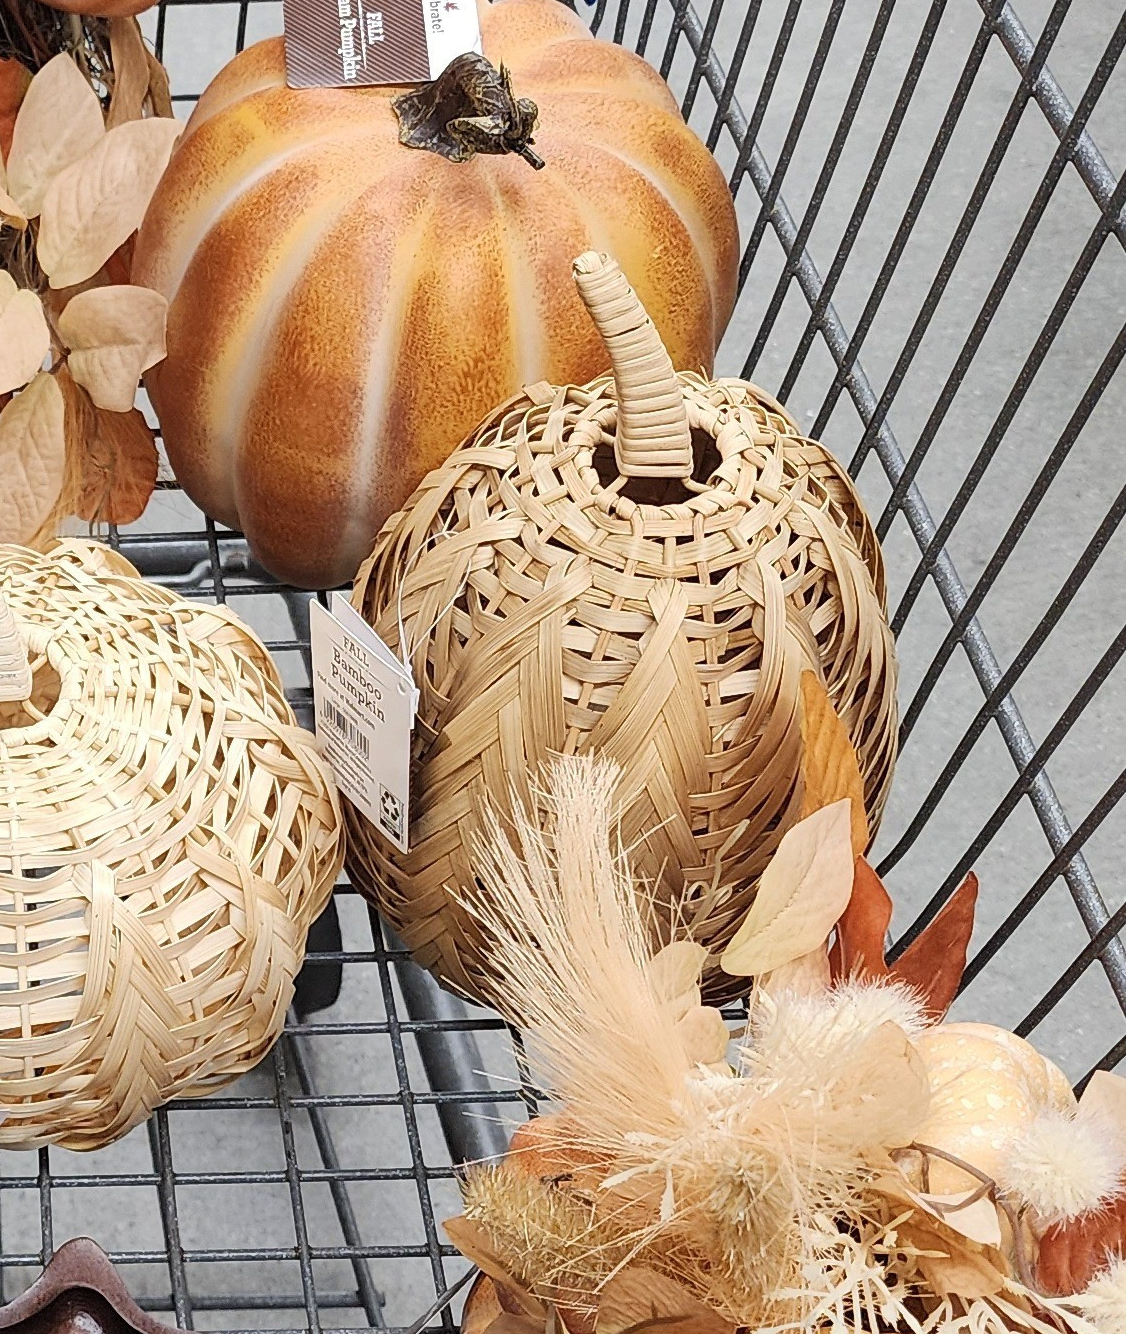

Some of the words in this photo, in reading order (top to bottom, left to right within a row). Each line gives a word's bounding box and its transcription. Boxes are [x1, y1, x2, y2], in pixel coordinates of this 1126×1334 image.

[338, 19, 361, 80] Pumpkin
[367, 12, 384, 44] FALL
[333, 646, 383, 702] Bamboo
[342, 634, 370, 668] FALL
[330, 661, 386, 723] Pumpkin
